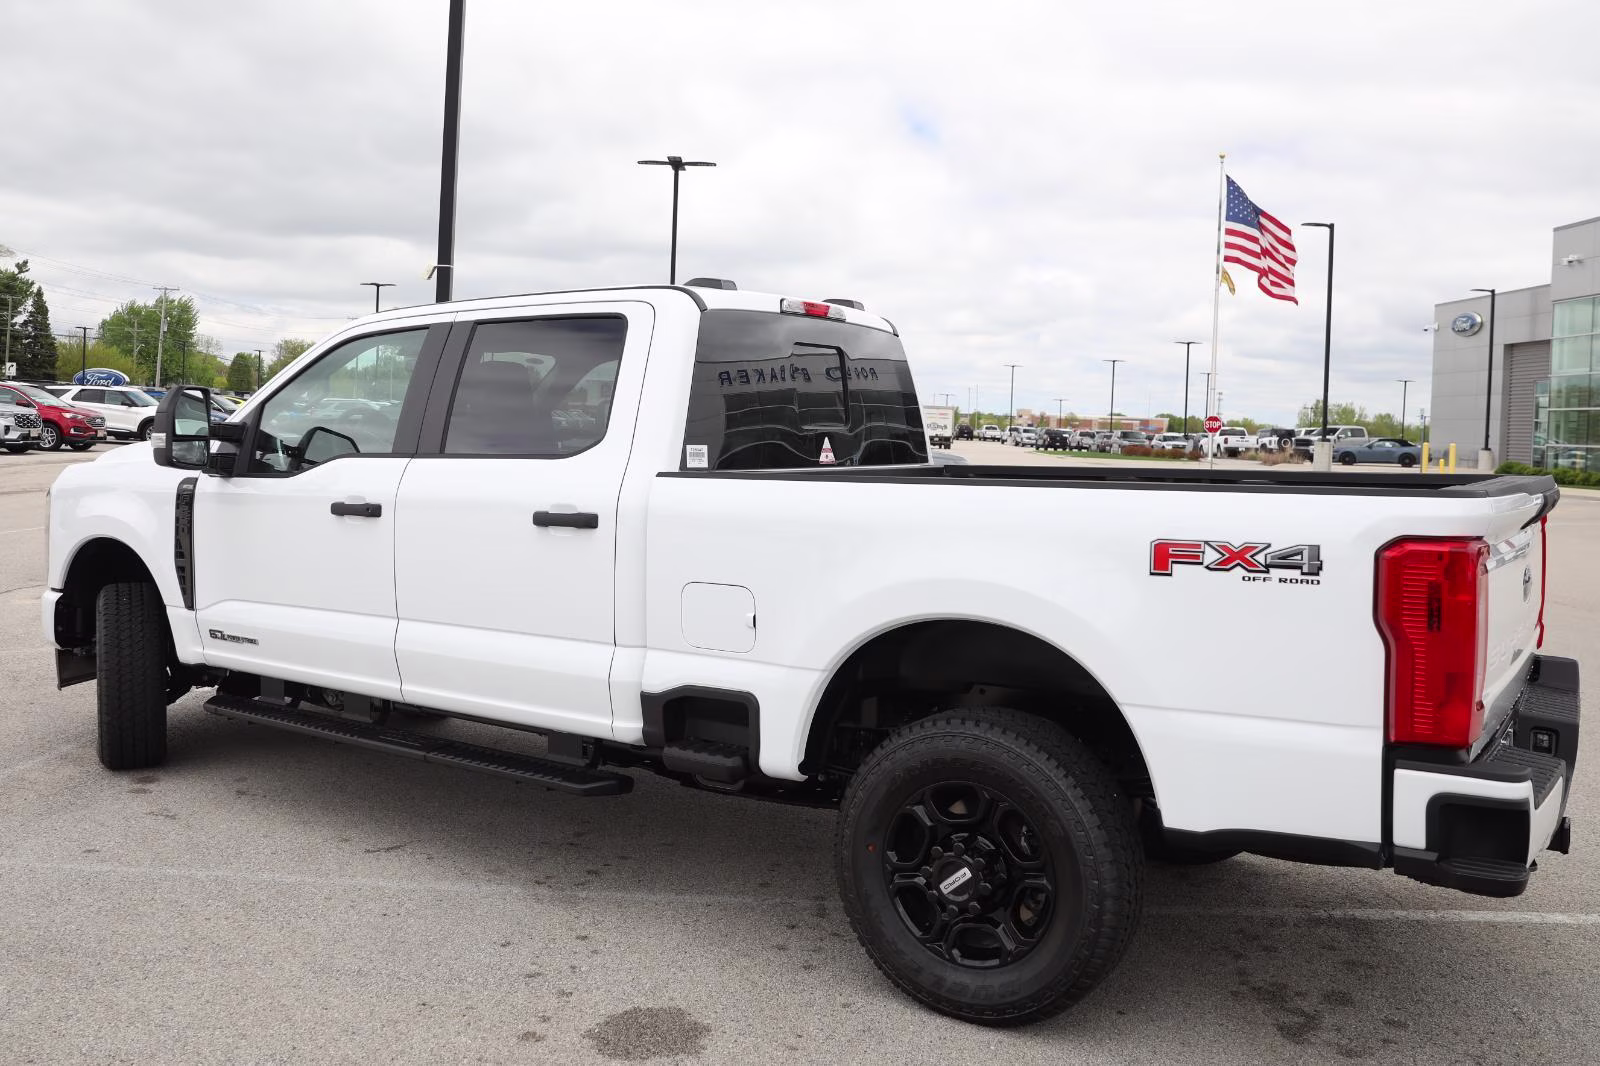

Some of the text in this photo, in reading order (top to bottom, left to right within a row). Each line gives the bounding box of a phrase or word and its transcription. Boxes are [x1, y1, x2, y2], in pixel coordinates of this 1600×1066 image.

[84, 371, 115, 386] Ford
[1205, 420, 1221, 429] STOP
[1149, 538, 1323, 577] FX4
[1241, 575, 1321, 586] OFF ROAD
[943, 871, 967, 890] FORD
